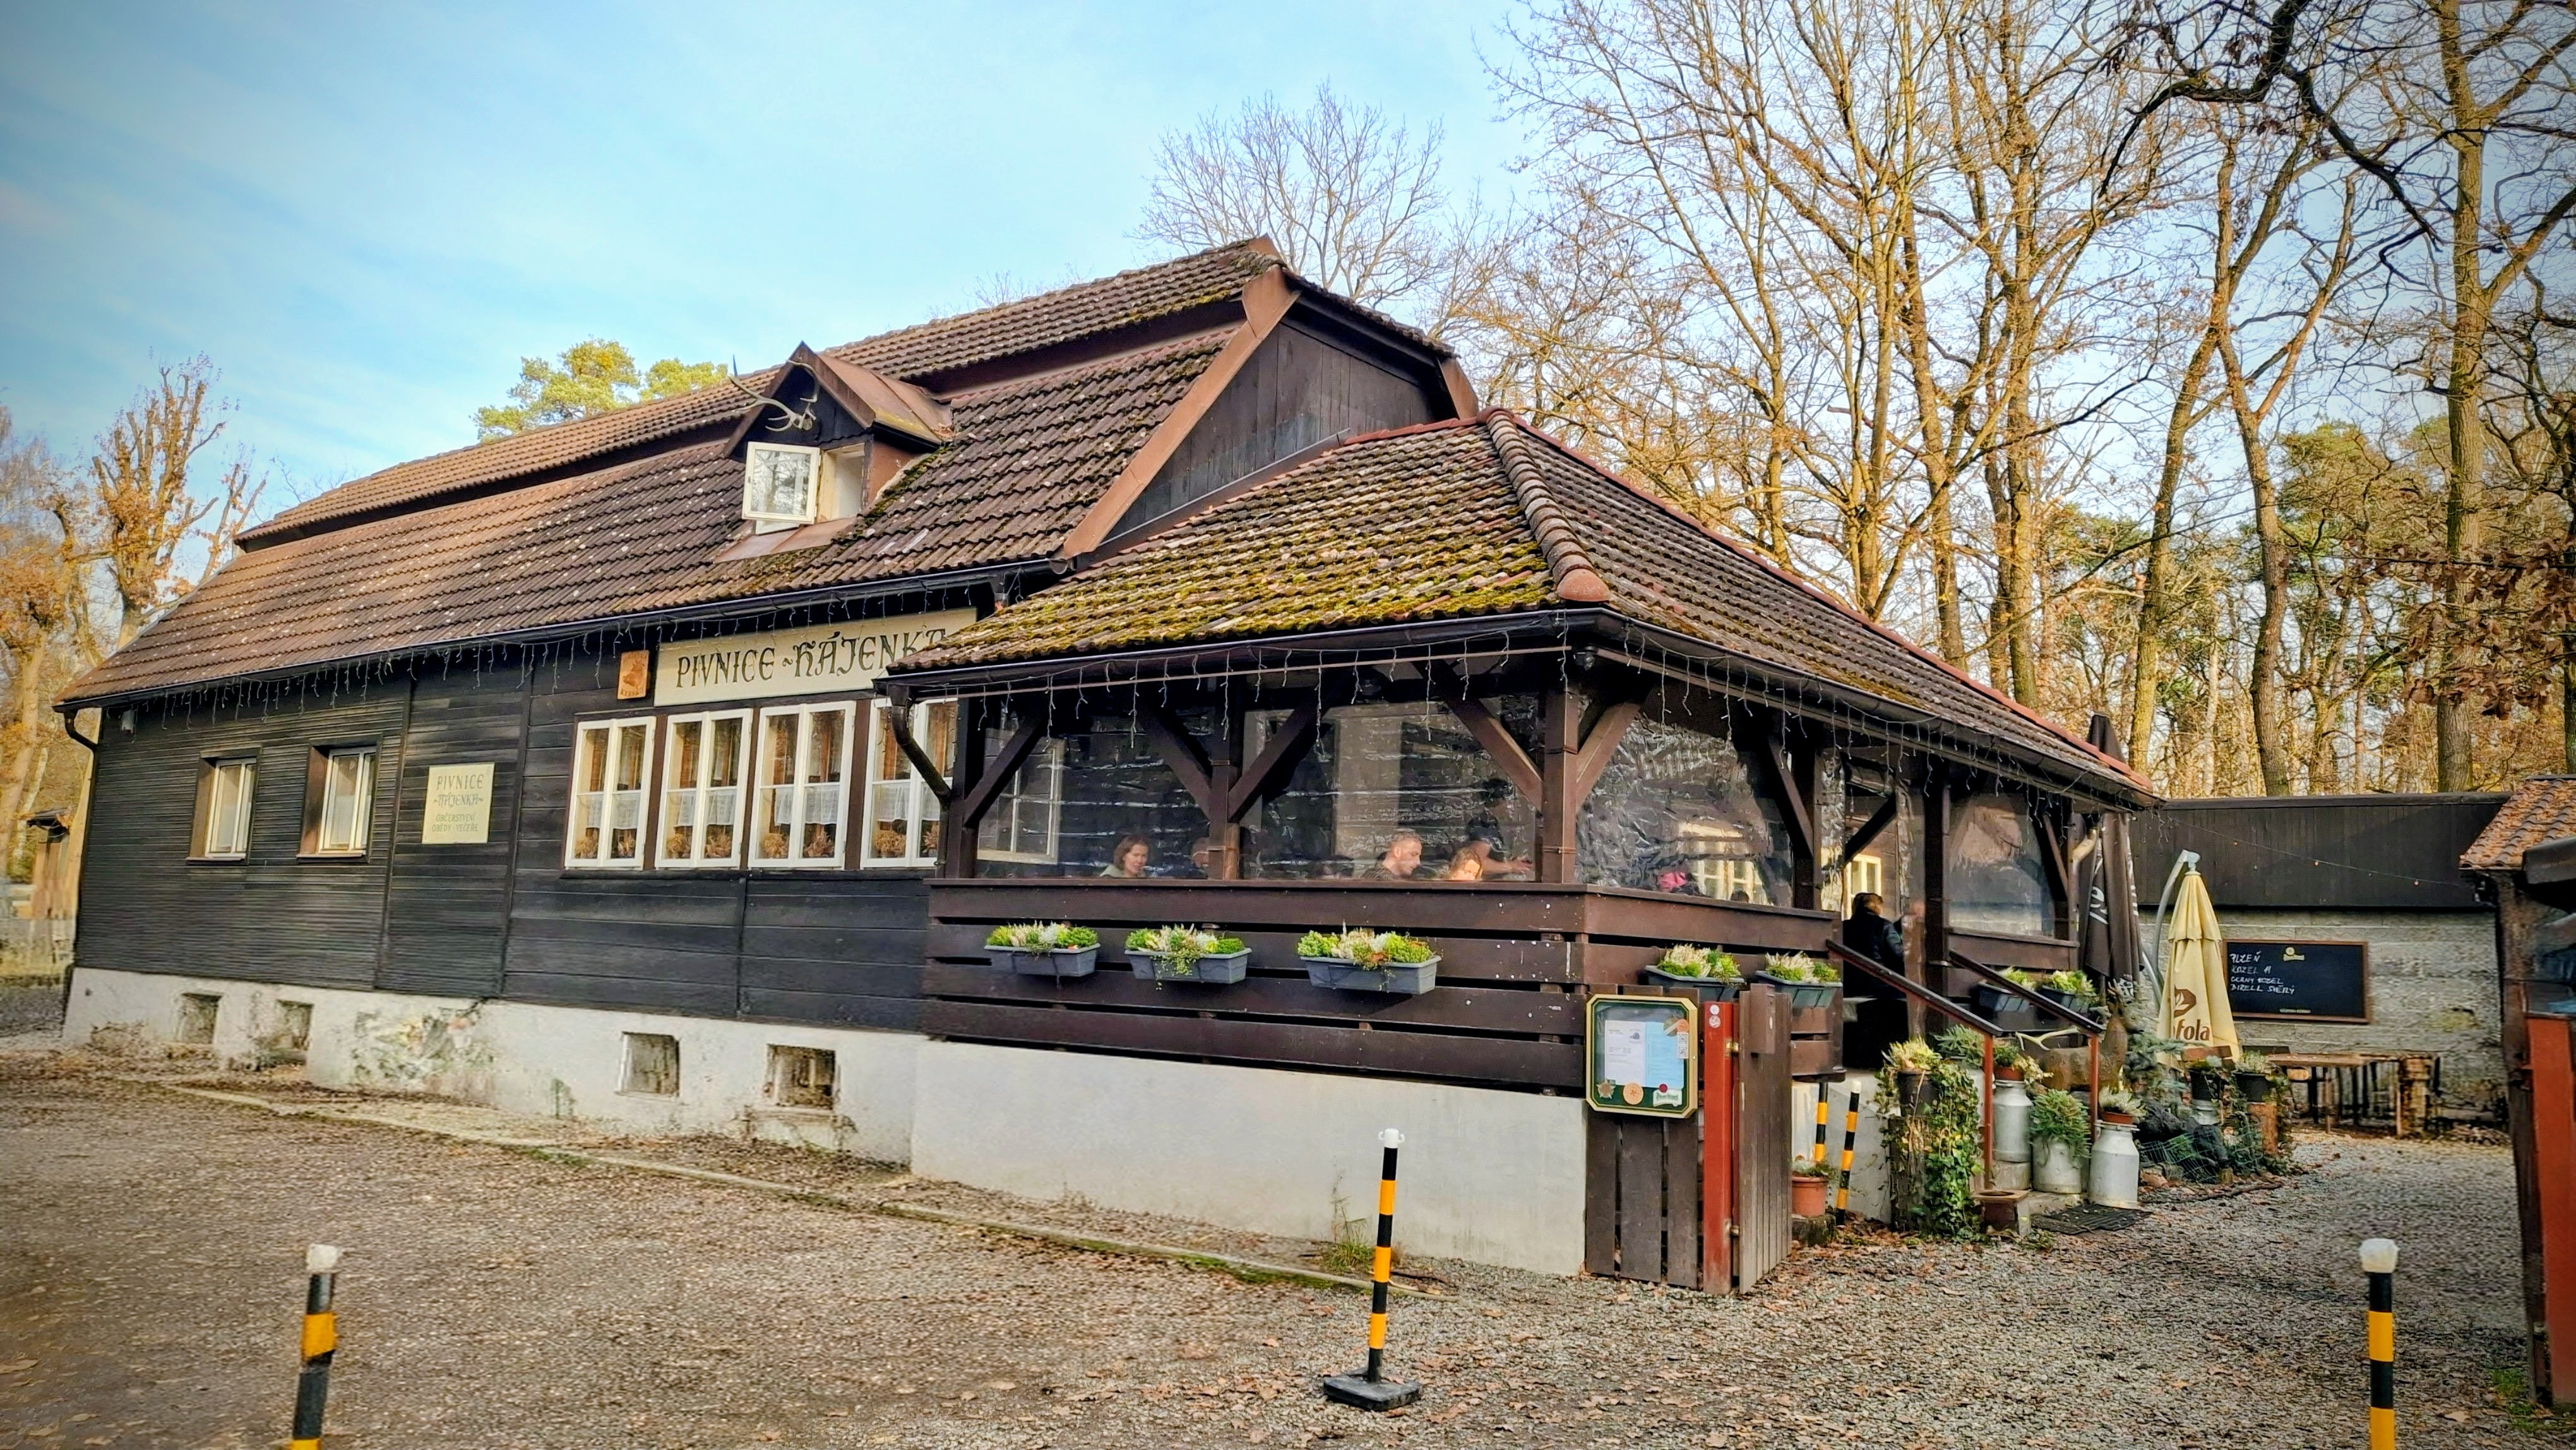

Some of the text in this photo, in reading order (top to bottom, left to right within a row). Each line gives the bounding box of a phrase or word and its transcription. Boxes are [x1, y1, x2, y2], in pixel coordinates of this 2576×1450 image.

[676, 647, 775, 688] PIVNICE
[437, 774, 484, 790] PIVNICE
[436, 812, 476, 822] OBČERSTVENÍ
[432, 822, 451, 832] OBĚDY
[2173, 1018, 2210, 1041] fola
